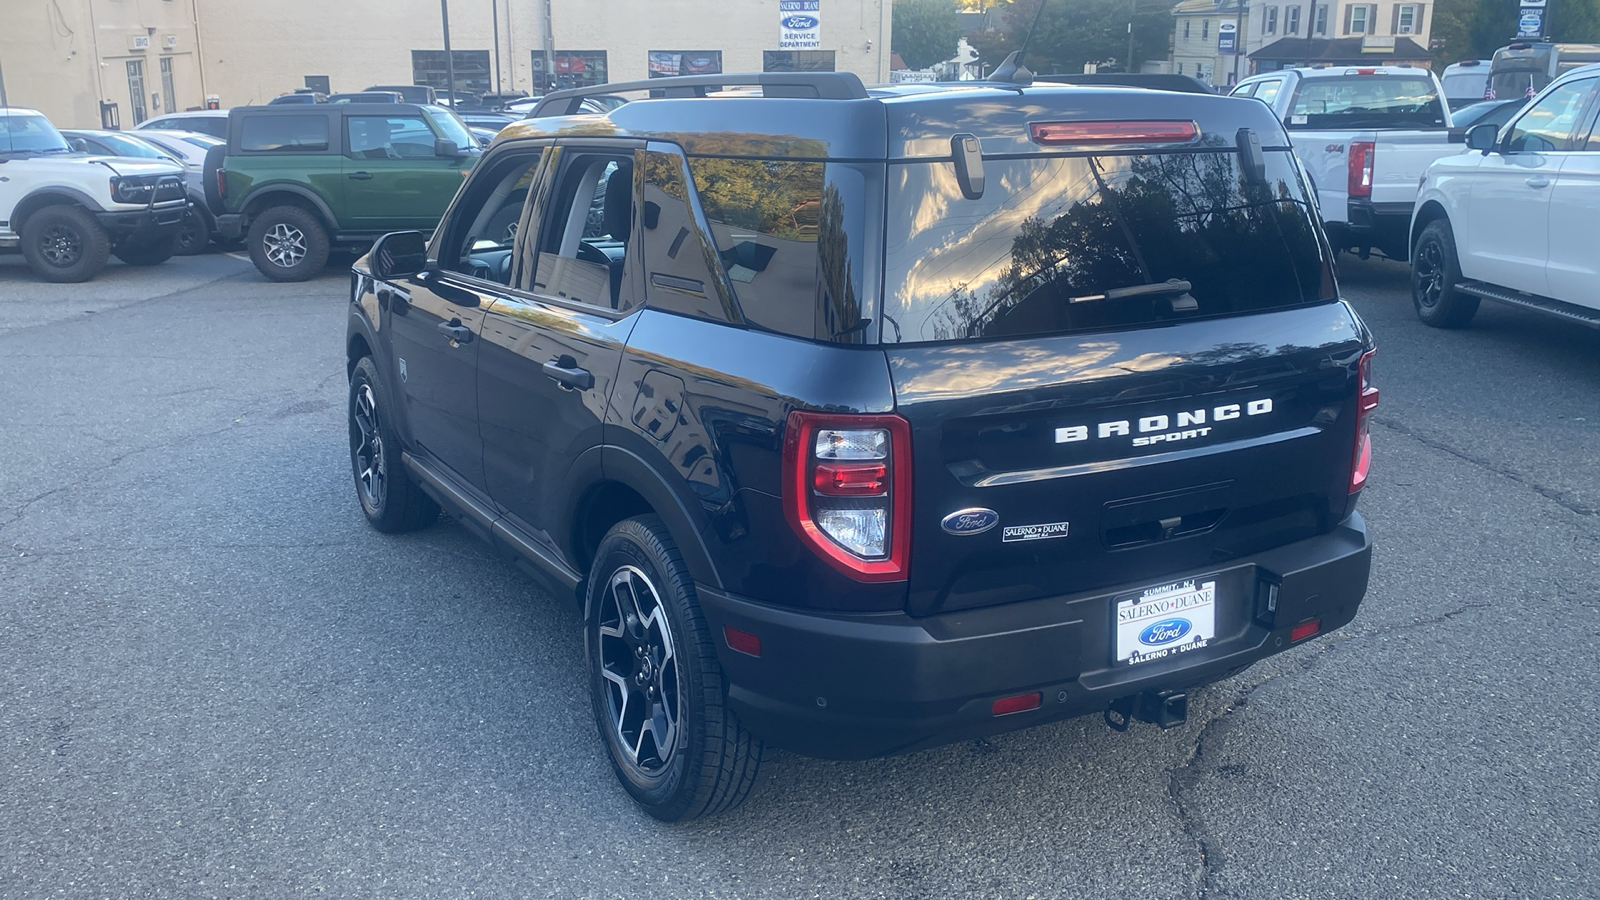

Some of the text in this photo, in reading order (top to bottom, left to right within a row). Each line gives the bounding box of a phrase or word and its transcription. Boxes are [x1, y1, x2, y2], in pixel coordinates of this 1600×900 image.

[780, 1, 819, 10] SALERNO DUANE
[788, 17, 812, 28] Ford
[1055, 398, 1273, 444] BRONCO
[1132, 427, 1212, 447] SPORT
[955, 513, 987, 530] Ford
[1005, 524, 1066, 537] SALERNO DUANE
[1143, 579, 1195, 597] SUMMIT, NJ
[1119, 591, 1212, 622] SALERNO DUANE
[1149, 622, 1182, 643] Ford
[1128, 639, 1208, 665] SALERNO DUANE
